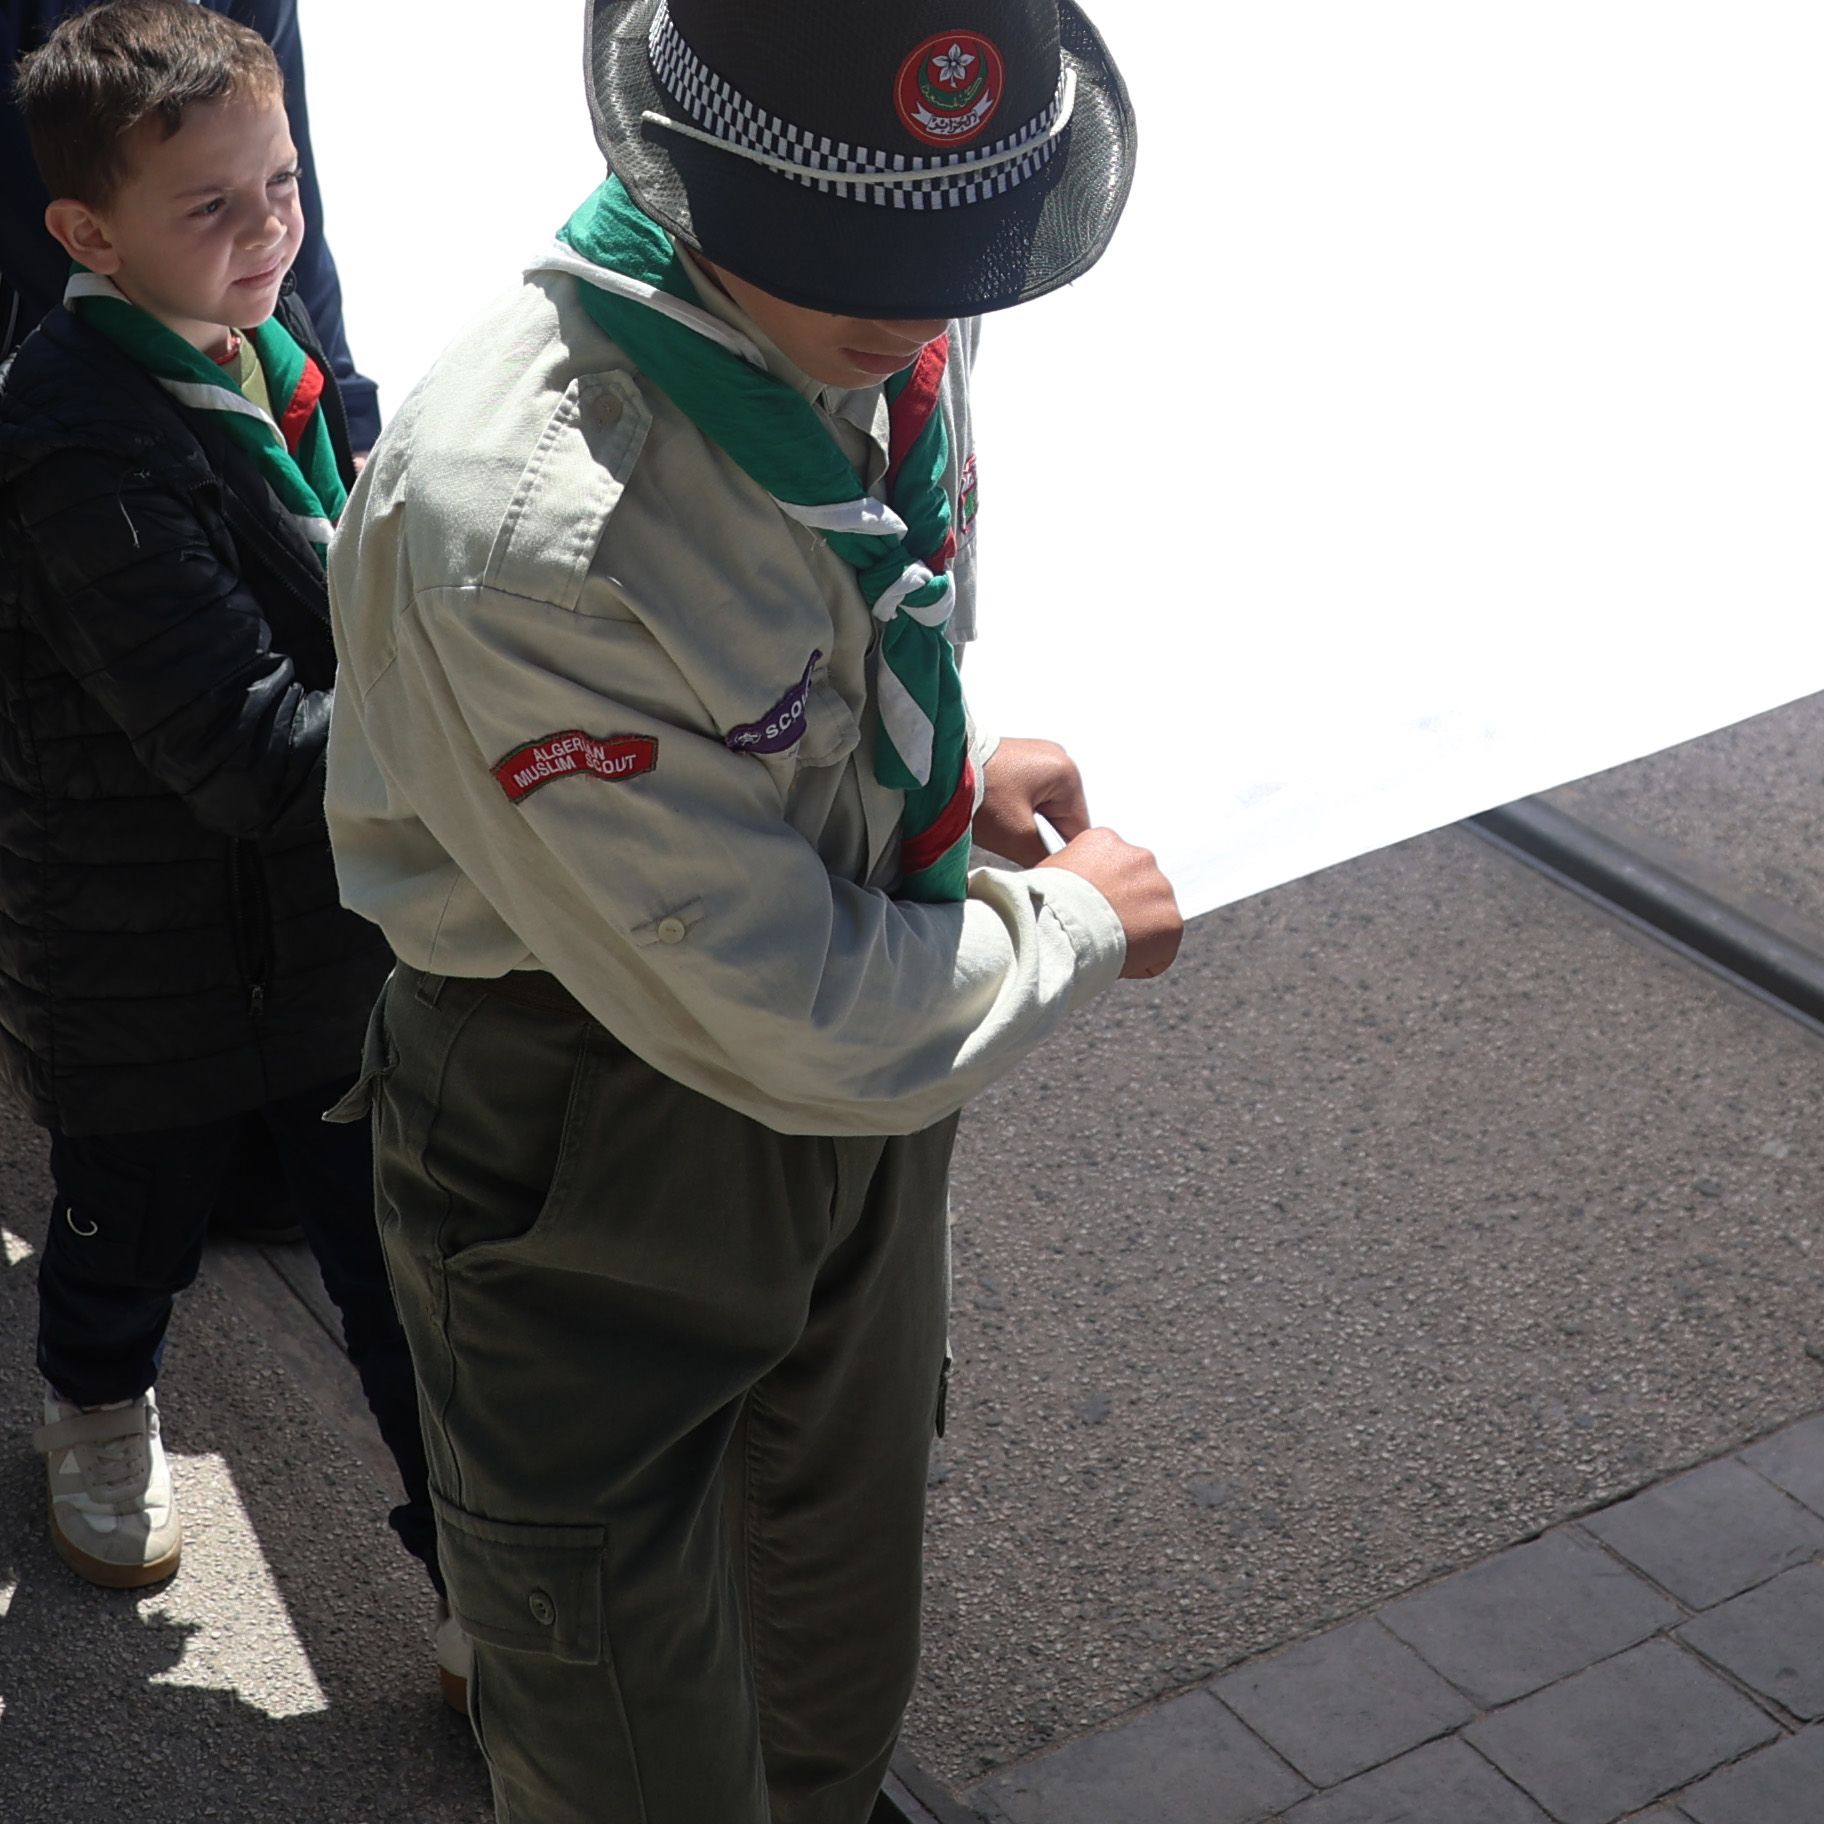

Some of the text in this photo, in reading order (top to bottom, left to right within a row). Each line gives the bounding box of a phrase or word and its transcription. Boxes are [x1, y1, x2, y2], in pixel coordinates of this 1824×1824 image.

[928, 112, 978, 134] الجزائر
[533, 736, 605, 762] ALGERIAN
[513, 753, 636, 788] MUSLIM SCOUT
